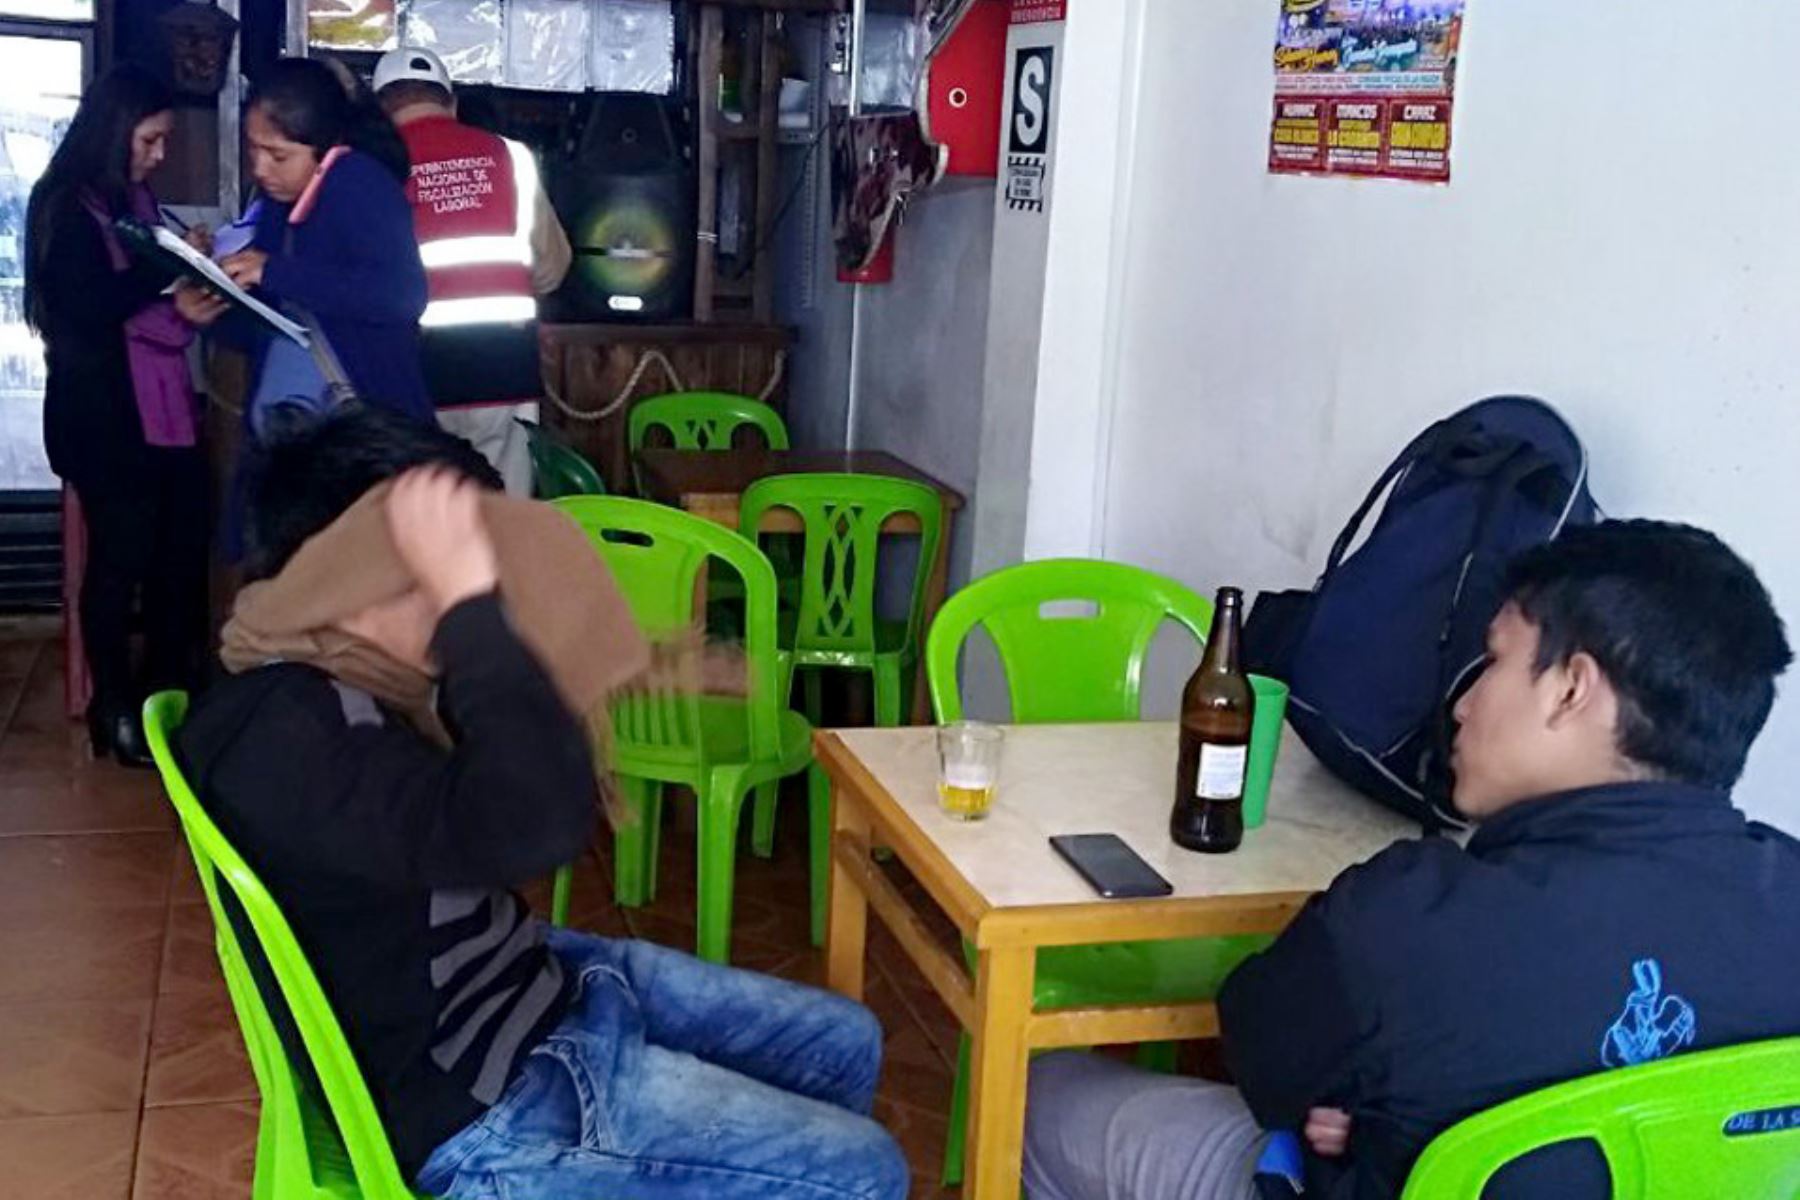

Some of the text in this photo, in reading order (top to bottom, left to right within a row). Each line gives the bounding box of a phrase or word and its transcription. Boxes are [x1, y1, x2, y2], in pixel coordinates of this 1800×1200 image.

[1015, 55, 1045, 146] S
[410, 156, 496, 177] PERINTENDENCIA
[417, 169, 489, 188] NACIONAL DE
[433, 196, 483, 214] LABORAL
[1728, 1113, 1756, 1132] DE
